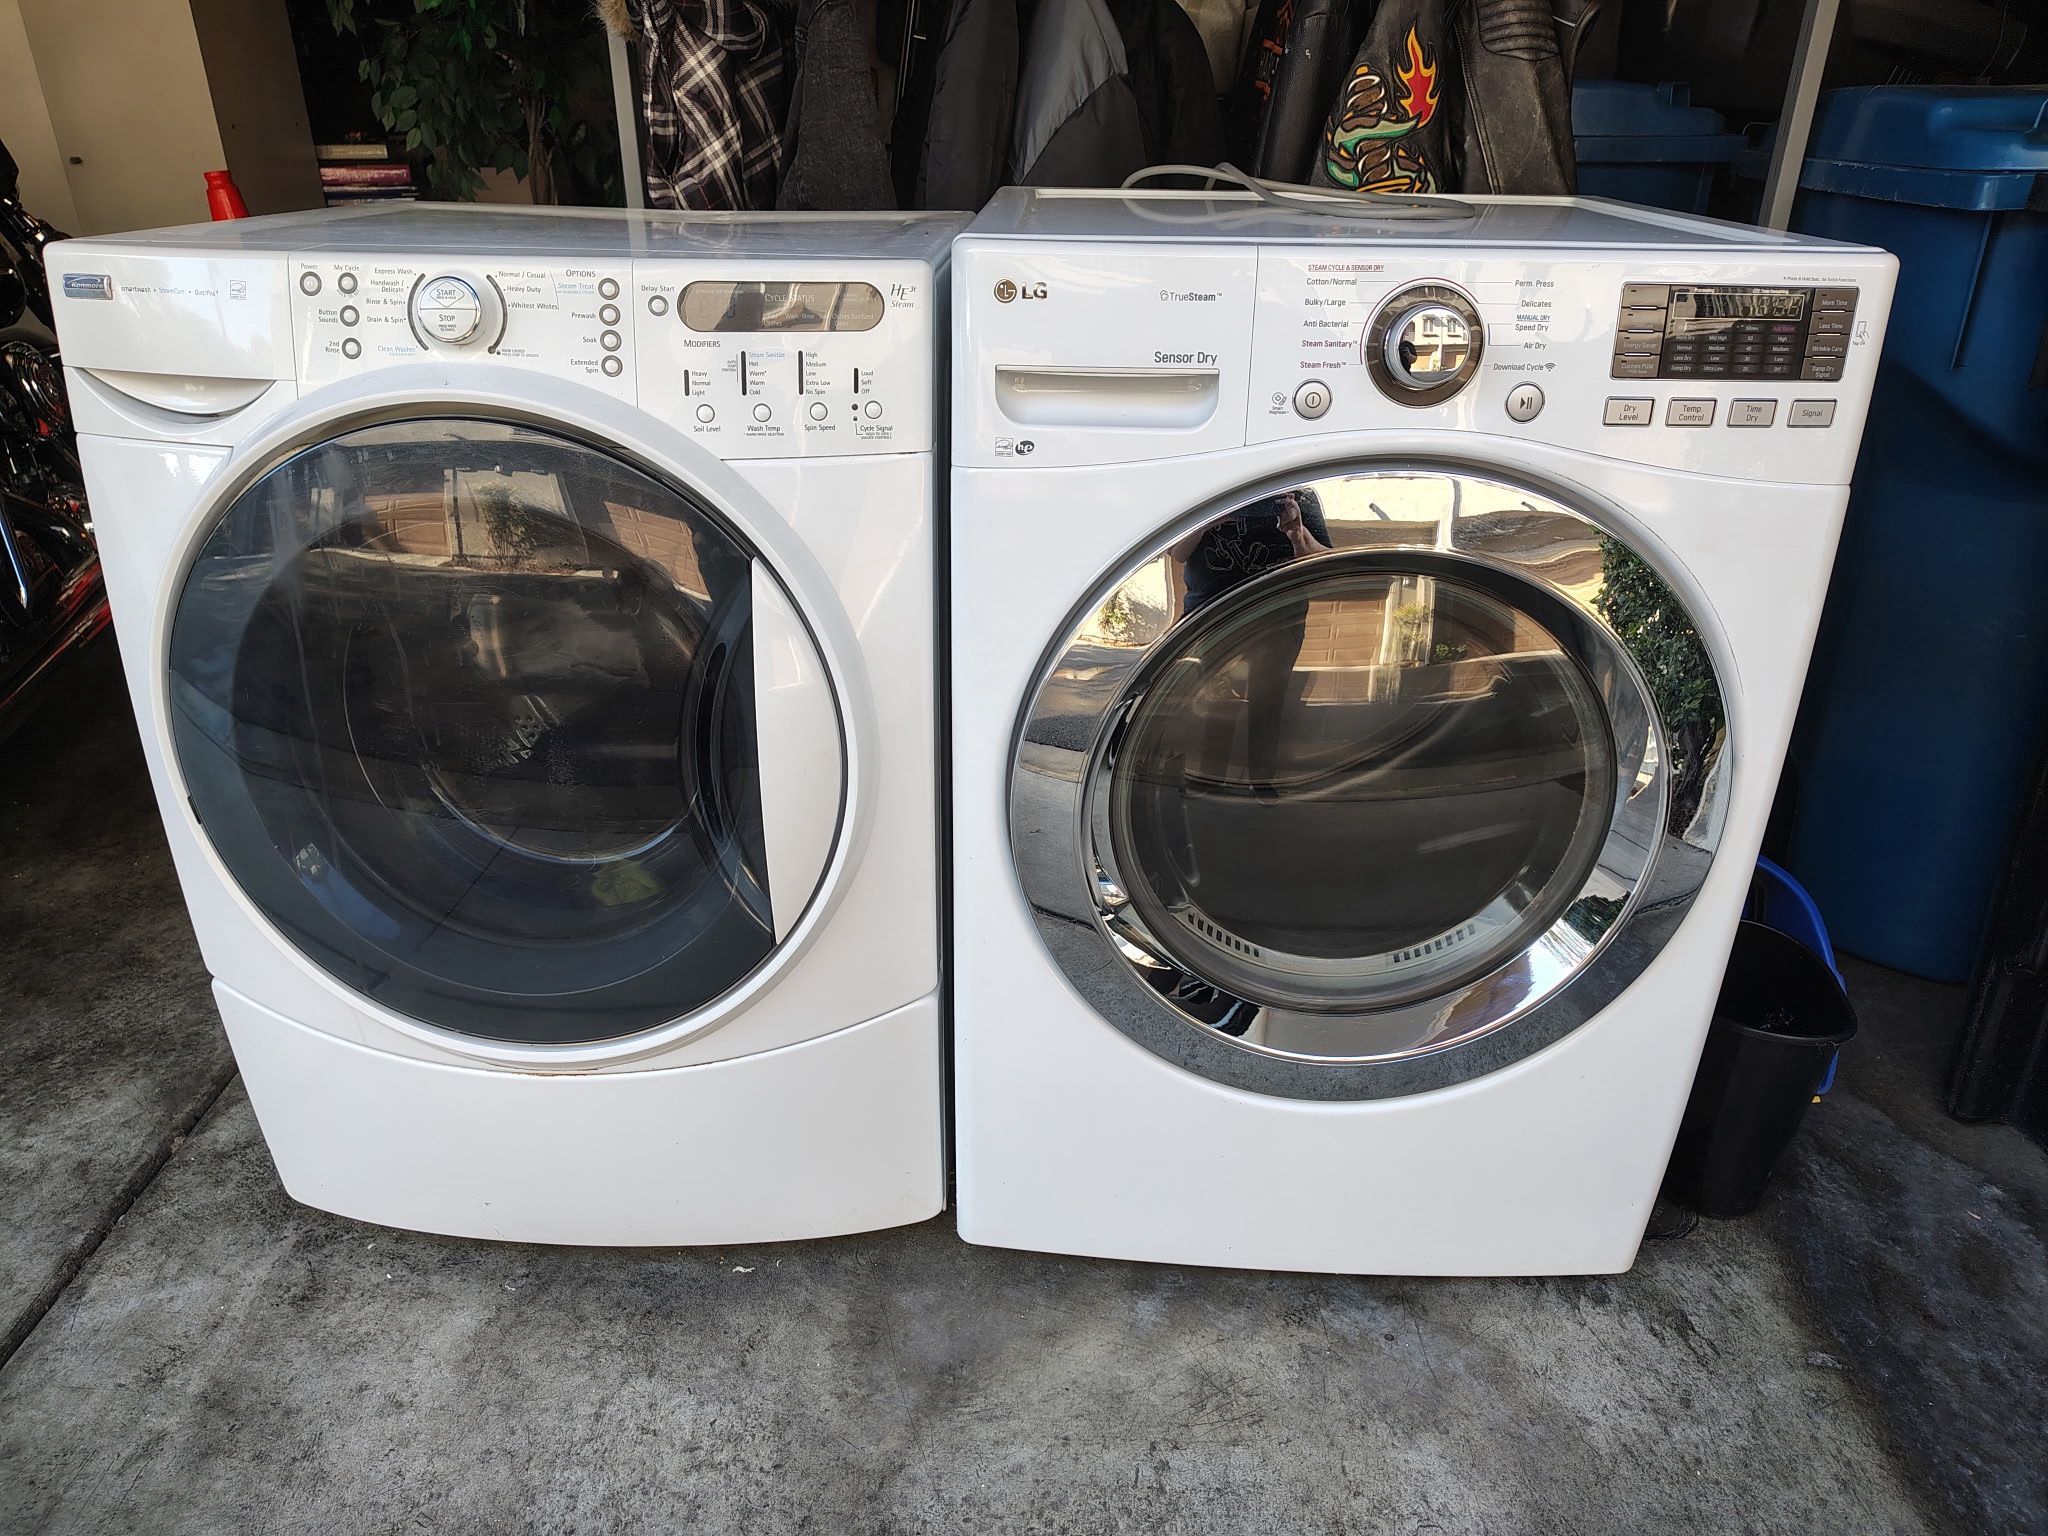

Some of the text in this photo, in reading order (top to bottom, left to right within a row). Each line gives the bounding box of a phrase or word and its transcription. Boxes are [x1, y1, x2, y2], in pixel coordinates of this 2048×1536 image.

[566, 269, 596, 278] OPTIONS
[72, 281, 104, 289] Kenmore
[1021, 282, 1048, 300] LG
[390, 298, 402, 306] Spin
[765, 294, 815, 302] CYCLE STATUS
[1305, 298, 1346, 307] Bulky/Large
[1521, 300, 1552, 308] Delicates
[391, 316, 403, 324] Spin
[439, 314, 456, 322] STOP
[1537, 324, 1549, 332] Dry
[684, 340, 721, 348] MODIFIERS
[1534, 342, 1547, 350] Dry
[1154, 351, 1218, 366] Sensor Dry
[1300, 361, 1321, 369] Steam
[1493, 363, 1544, 372] Download Cycle
[1624, 404, 1636, 414] Dry
[1746, 405, 1762, 413] Time
[1619, 412, 1639, 421] Level
[1678, 413, 1704, 422] Control
[1802, 409, 1823, 418] Signal
[1746, 413, 1758, 423] Dry
[766, 425, 781, 434] Temp
